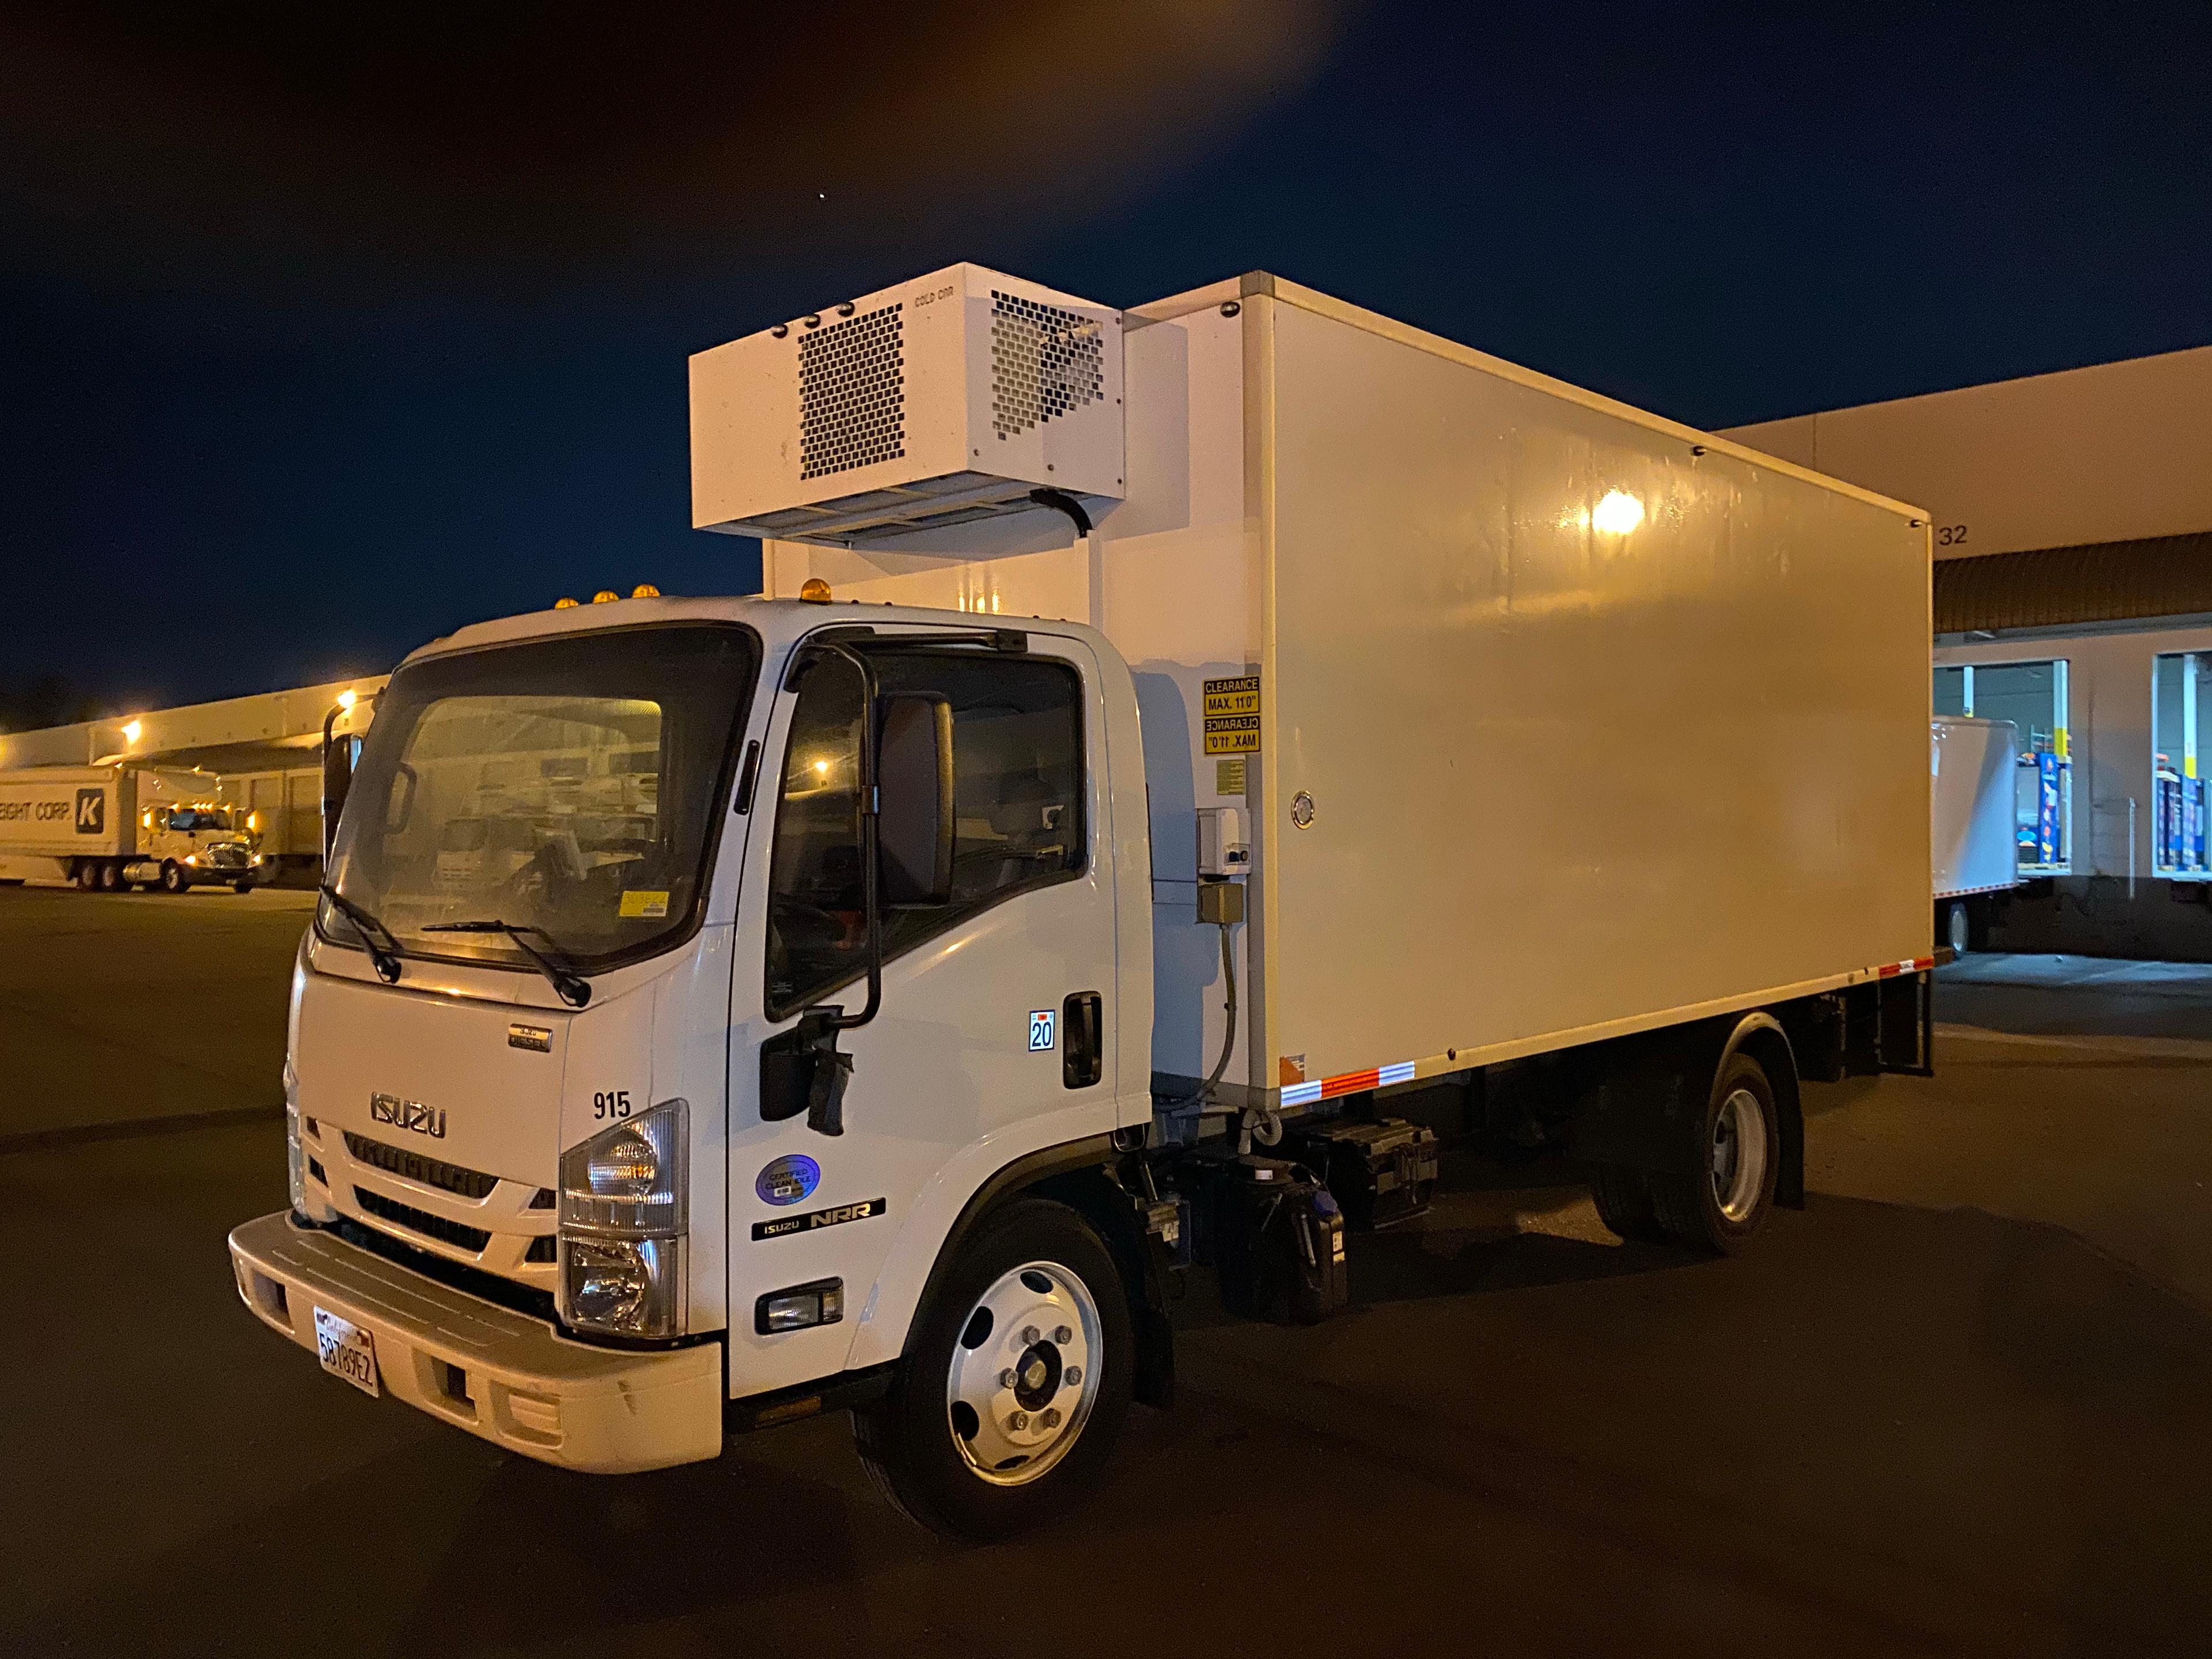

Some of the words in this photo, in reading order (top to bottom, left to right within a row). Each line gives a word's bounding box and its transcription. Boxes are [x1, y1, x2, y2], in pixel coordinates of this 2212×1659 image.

[1939, 525, 1967, 546] 32
[1206, 679, 1258, 693] CLEARANCE
[1209, 697, 1232, 710] MAX.
[36, 802, 72, 820] CORP.
[78, 797, 102, 825] K
[1032, 1021, 1052, 1047] 20
[370, 1091, 446, 1138] ISUZU
[594, 1091, 631, 1119] 915
[766, 1179, 792, 1190] CLEAN
[795, 1175, 811, 1184] IDLE
[770, 1169, 808, 1181] CERTIFIED
[764, 1220, 800, 1234] ISUZU
[810, 1203, 871, 1228] NRR
